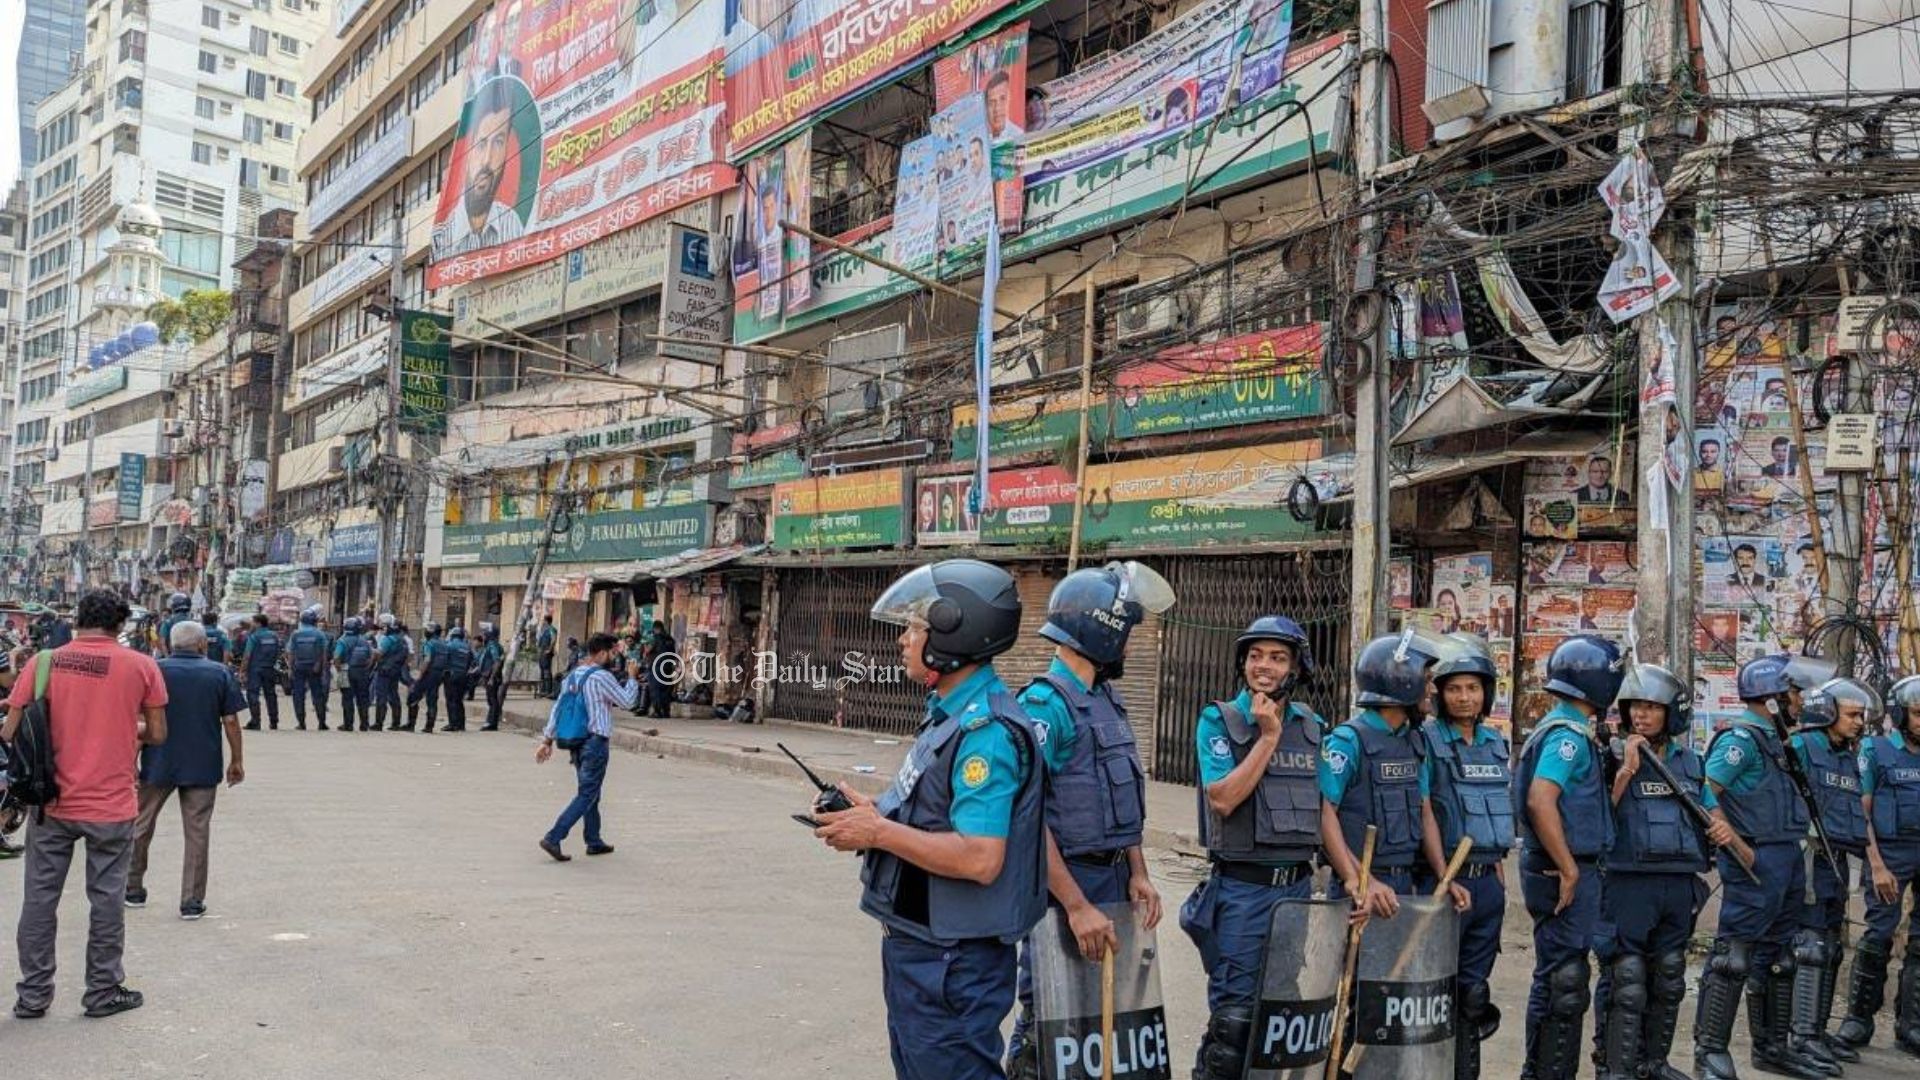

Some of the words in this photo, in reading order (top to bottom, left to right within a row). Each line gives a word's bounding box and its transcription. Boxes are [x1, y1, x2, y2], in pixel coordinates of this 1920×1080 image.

[546, 129, 605, 170] রফিকুল
[608, 94, 656, 140] আলম
[438, 252, 500, 284] রফিকুল
[505, 238, 554, 265] আলম
[677, 279, 717, 300] ELECTRO
[403, 355, 445, 376] PUBALI
[407, 372, 439, 394] BANK
[590, 524, 626, 542] PUBALI
[625, 521, 652, 539] BANK
[653, 517, 699, 537] LIMITED
[1092, 607, 1127, 632] POLICE
[1268, 752, 1316, 770] OLICE
[1386, 994, 1449, 1027] POLICE
[1263, 1009, 1334, 1055] POLIC
[1055, 1022, 1167, 1080] POLICE
